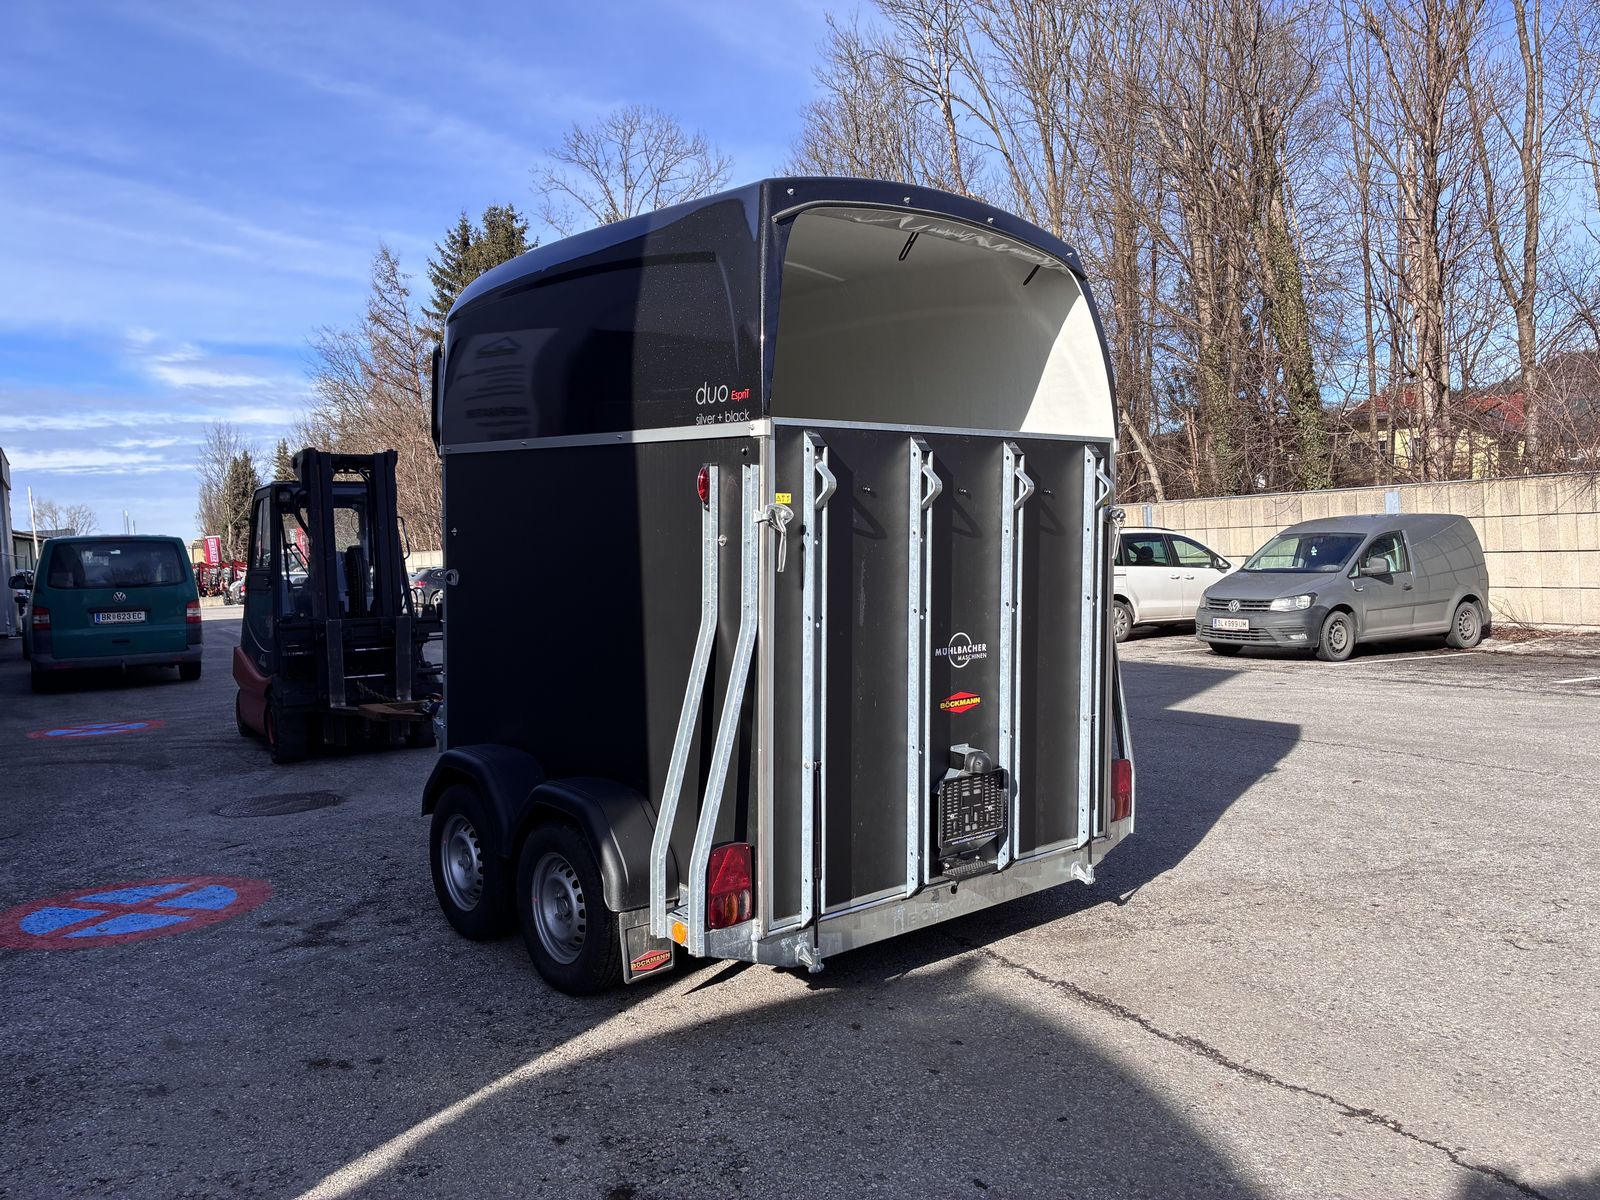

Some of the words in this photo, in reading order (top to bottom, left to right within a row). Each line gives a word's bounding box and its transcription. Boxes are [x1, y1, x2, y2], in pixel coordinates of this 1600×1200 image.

[695, 381, 729, 405] duo
[695, 413, 716, 426] silver
[724, 408, 750, 423] black
[101, 613, 112, 621] BR
[116, 612, 132, 620] 623
[132, 612, 142, 620] EC
[934, 643, 987, 657] MÜHLBACHER
[957, 652, 988, 661] MASCHINEN
[940, 696, 981, 709] BÖCKMANN
